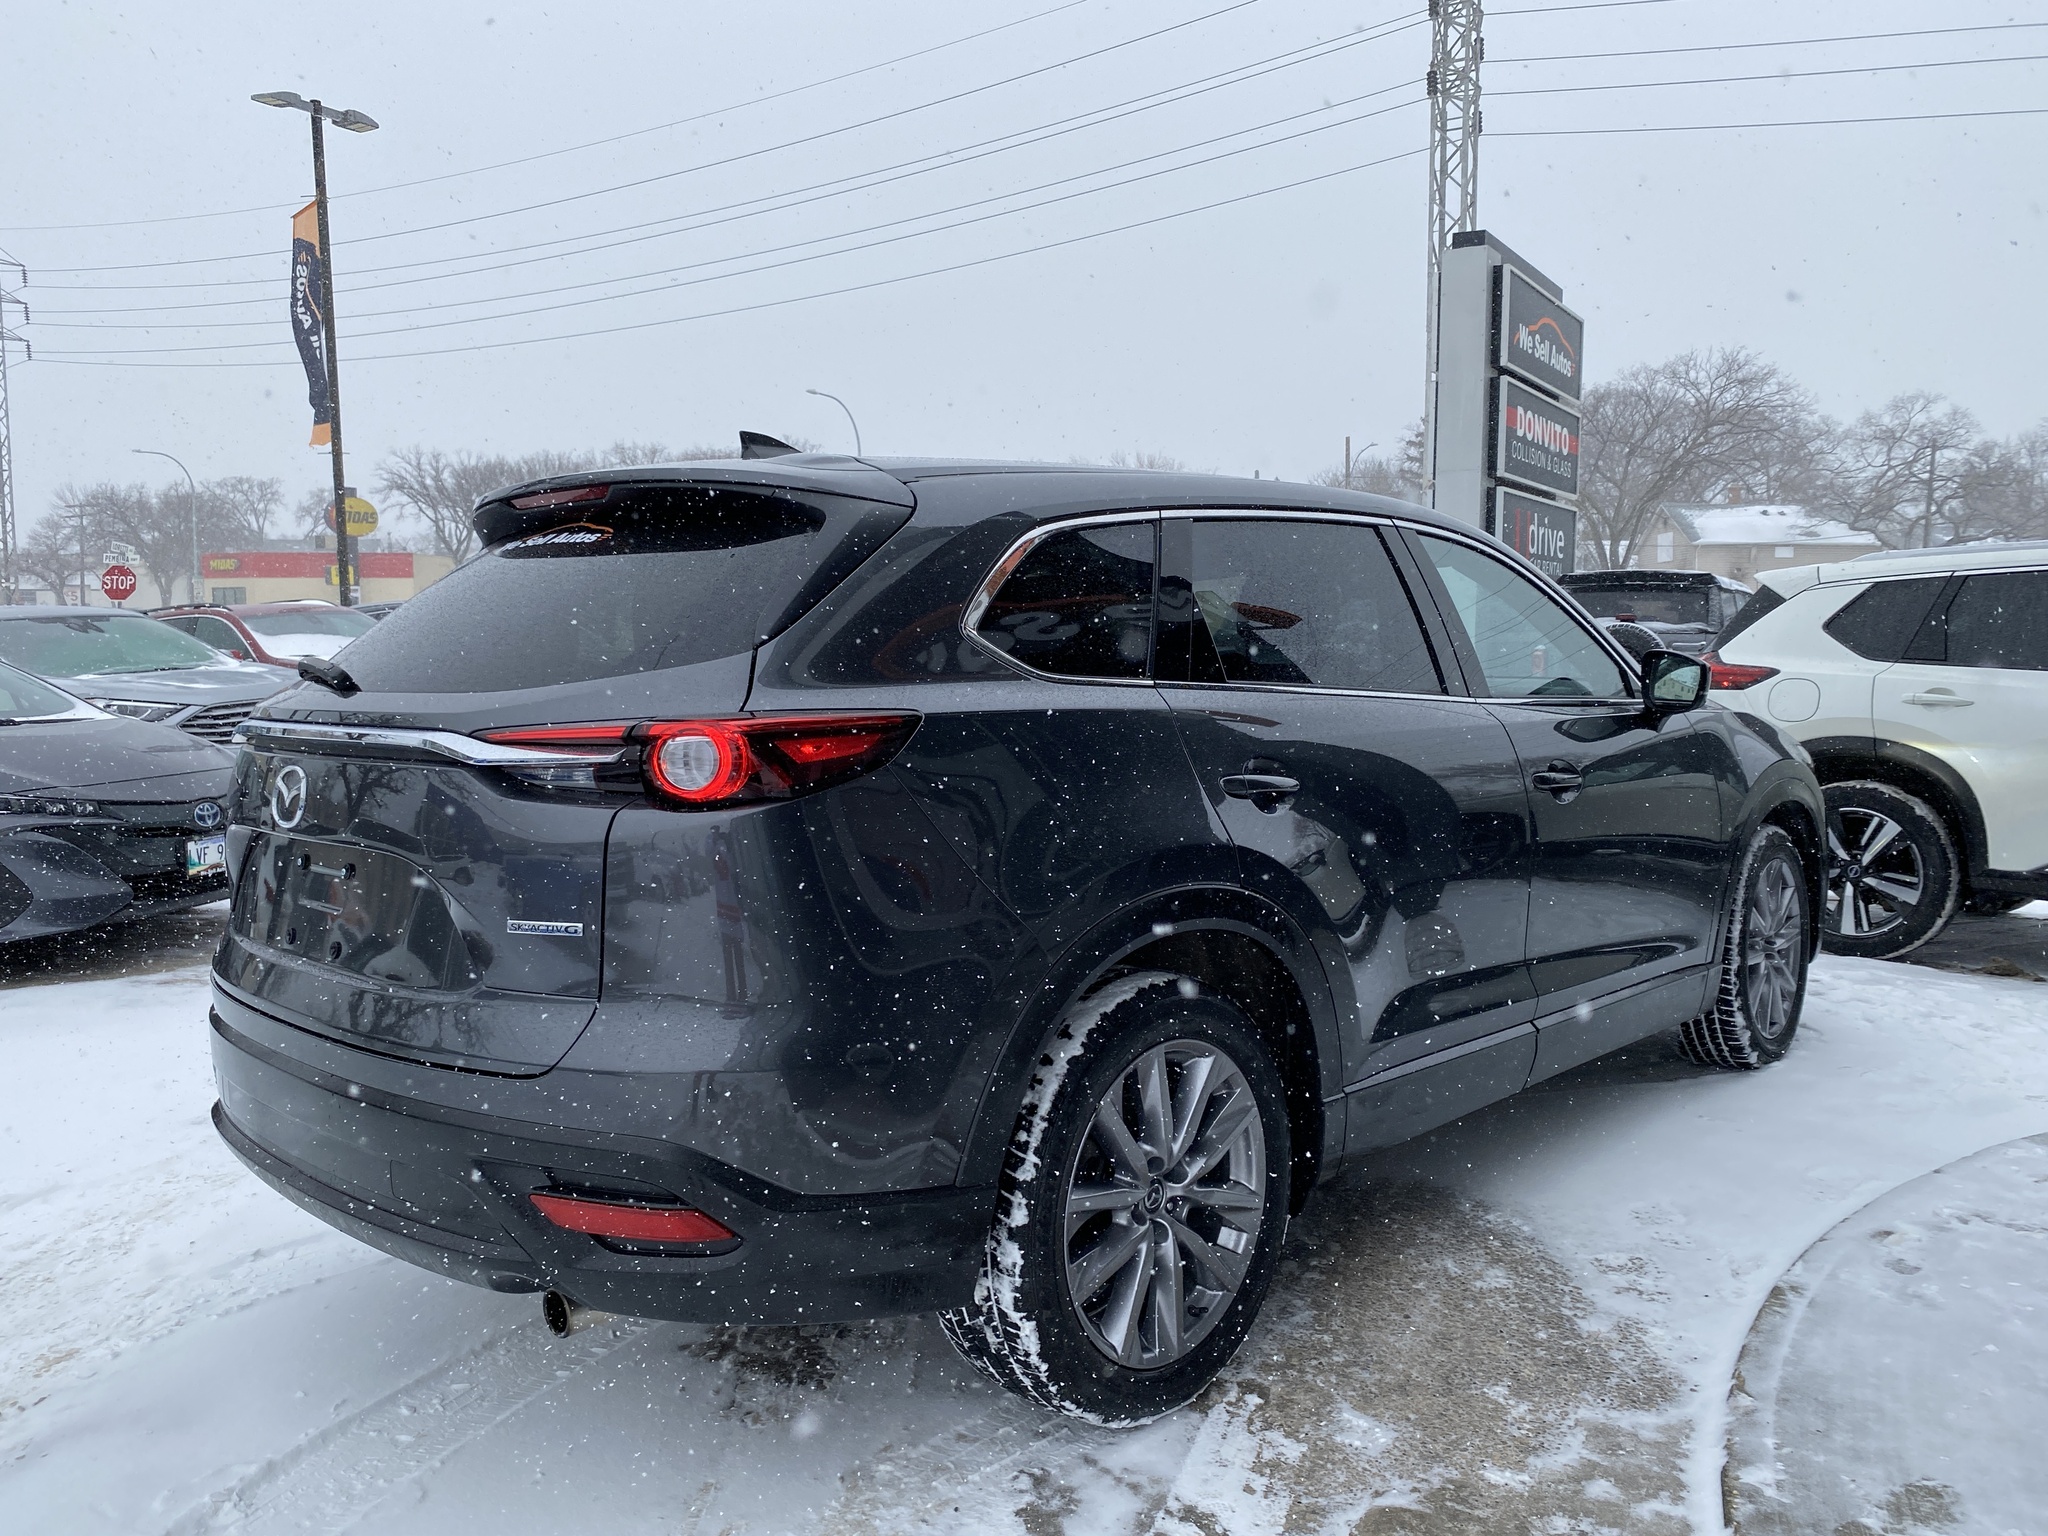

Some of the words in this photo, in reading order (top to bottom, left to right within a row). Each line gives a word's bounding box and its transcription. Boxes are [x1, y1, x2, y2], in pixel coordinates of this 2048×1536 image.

[1518, 323, 1533, 354] We
[1534, 333, 1550, 364] Sell
[1550, 345, 1572, 378] Autos
[1516, 405, 1569, 456] DONVITO
[1511, 441, 1547, 469] COLLISION
[1552, 457, 1572, 478] GLASS
[345, 511, 377, 524] IDAS
[546, 531, 602, 544] Autos
[209, 558, 238, 570] MIDAS
[1542, 559, 1563, 576] RENTAL
[103, 575, 135, 590] STOP
